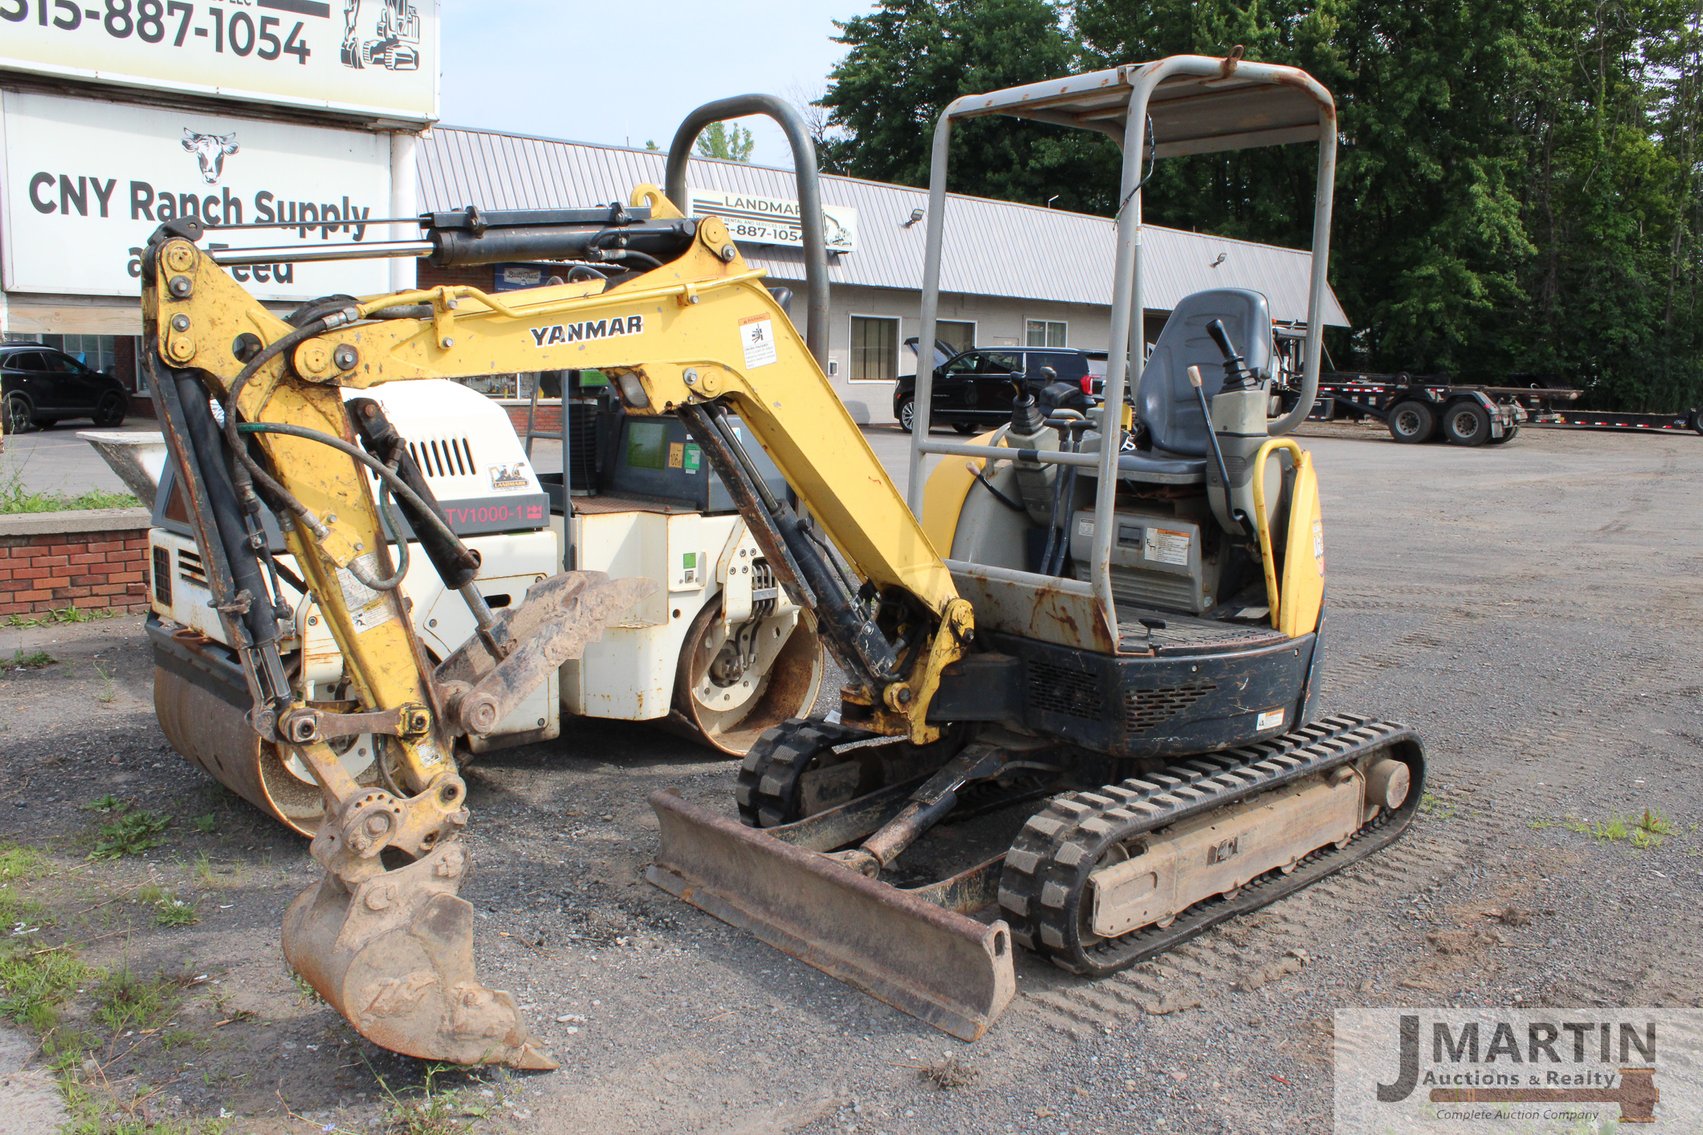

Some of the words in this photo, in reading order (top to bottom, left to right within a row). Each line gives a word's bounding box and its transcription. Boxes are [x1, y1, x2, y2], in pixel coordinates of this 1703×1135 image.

[29, 171, 118, 218] CNY
[129, 180, 244, 225] Ranch
[254, 190, 370, 242] Supply
[530, 315, 643, 346] YANMAR
[445, 504, 524, 525] TV1000-1
